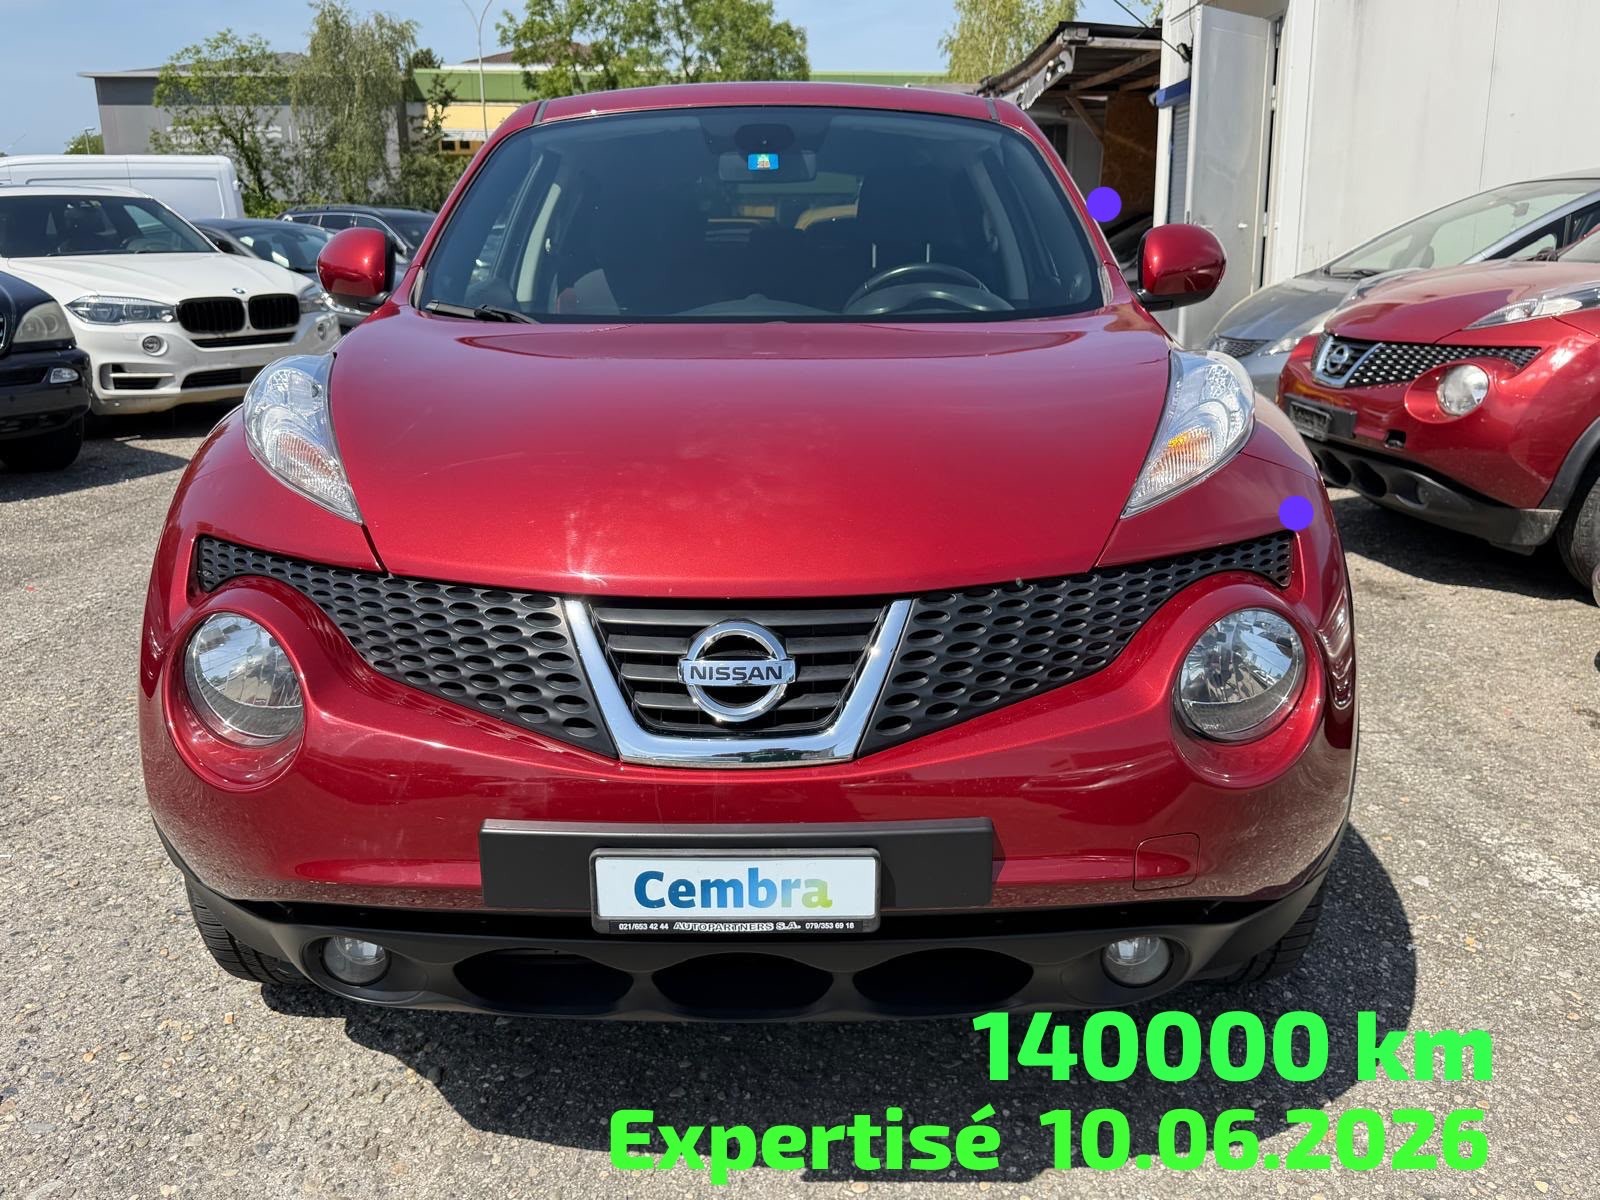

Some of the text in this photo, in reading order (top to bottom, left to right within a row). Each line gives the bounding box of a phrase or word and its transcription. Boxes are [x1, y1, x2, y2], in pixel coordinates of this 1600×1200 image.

[690, 665, 782, 681] NISSAN
[633, 867, 833, 909] Cembra
[618, 923, 648, 931] 021/653
[648, 923, 659, 931] 42
[659, 923, 669, 931] 44
[673, 921, 775, 932] AUTOPARTNERS
[775, 921, 802, 931] S.A.
[805, 922, 834, 930] 079/353
[835, 922, 844, 930] 69
